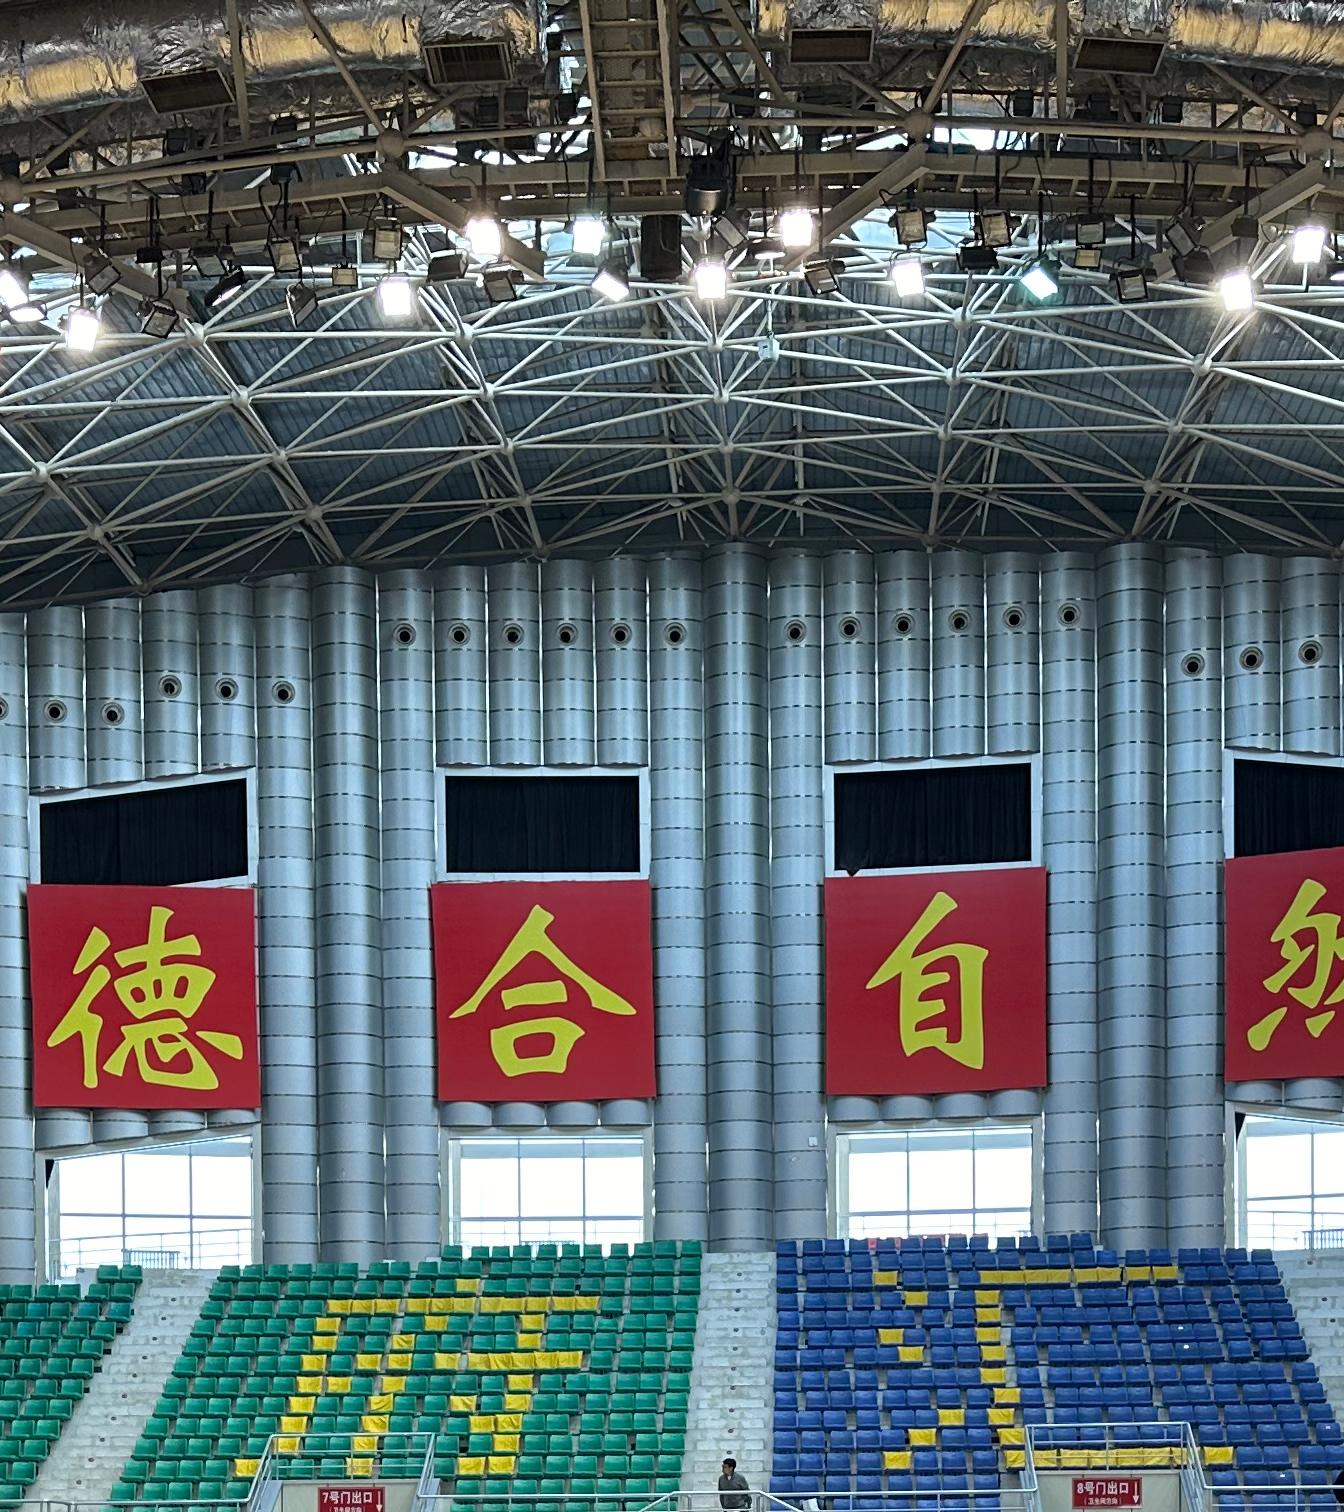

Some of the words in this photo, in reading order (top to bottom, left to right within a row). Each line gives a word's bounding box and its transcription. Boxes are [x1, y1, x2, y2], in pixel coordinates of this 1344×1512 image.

[47, 905, 244, 1089] 德
[448, 904, 637, 1077] 合
[865, 891, 989, 1070] 自
[322, 1490, 372, 1504] 7号门出口
[1077, 1481, 1129, 1495] 8号门出口
